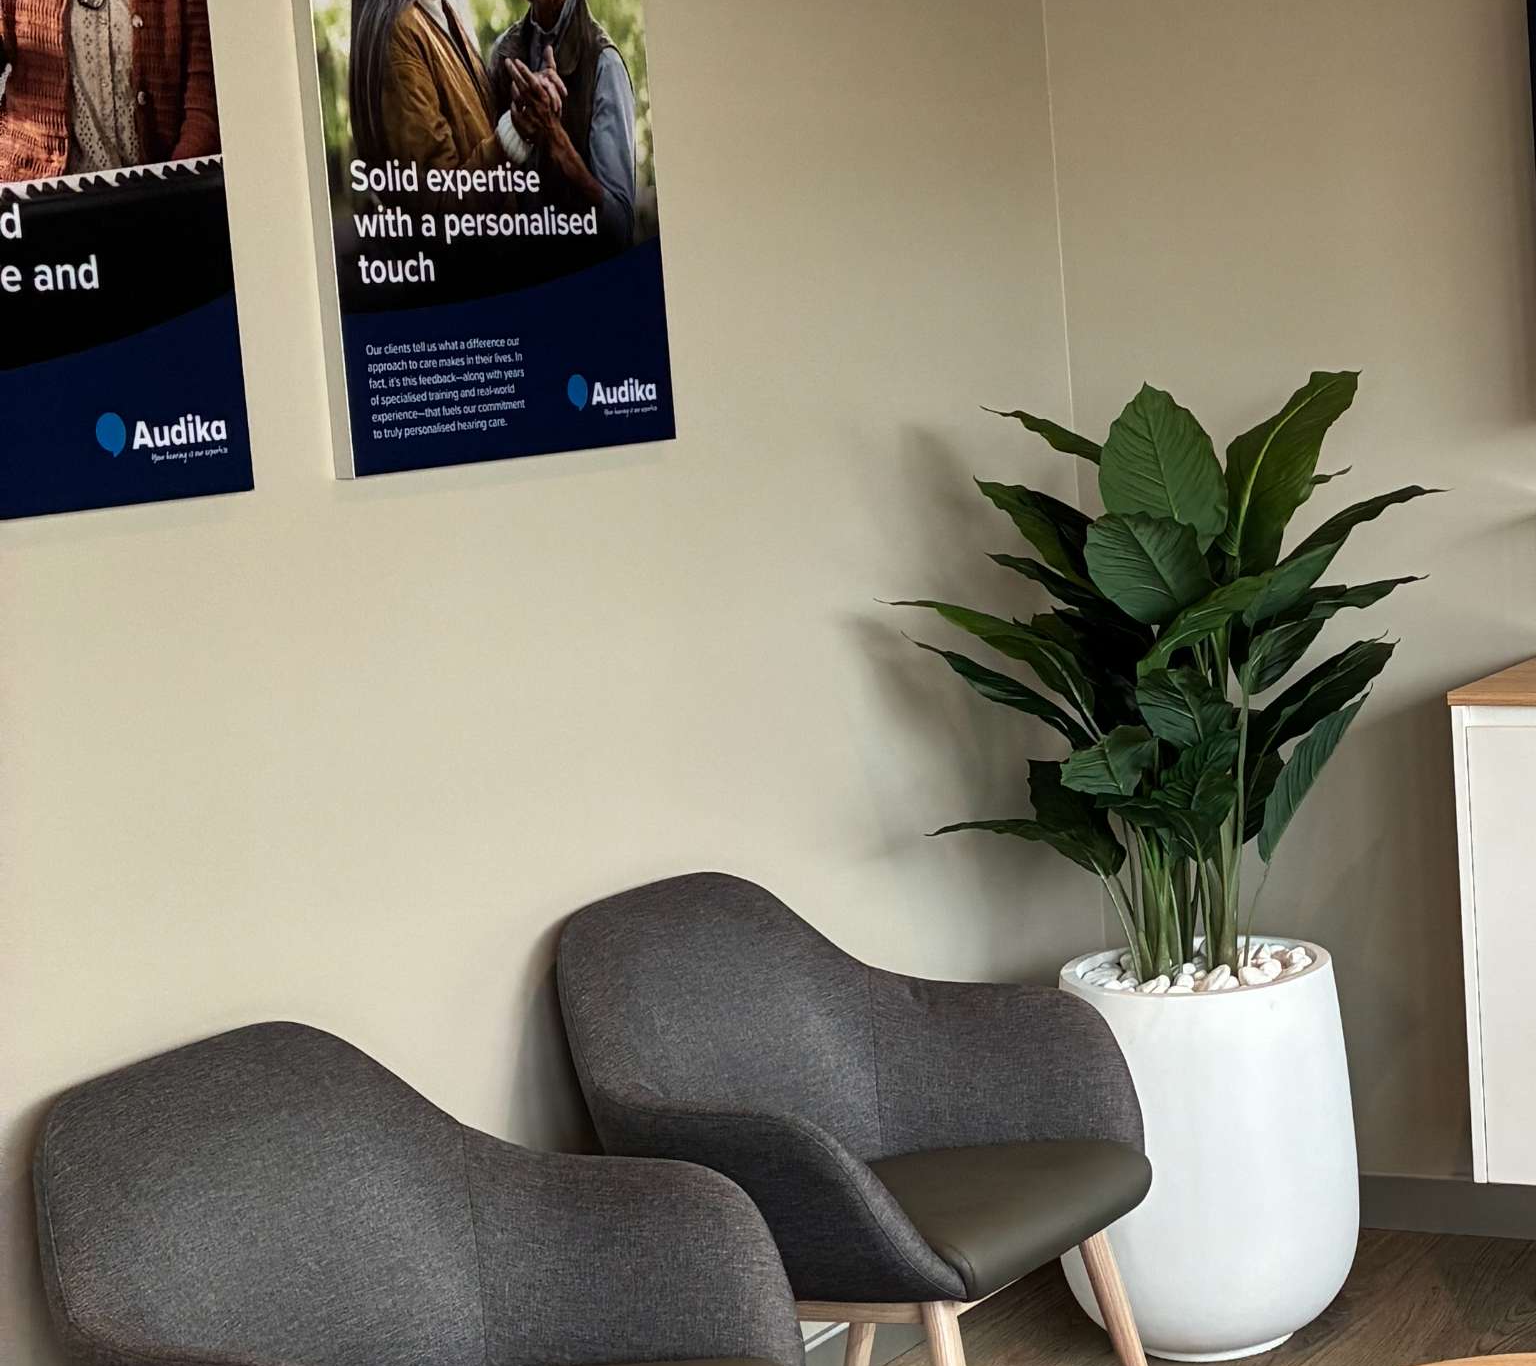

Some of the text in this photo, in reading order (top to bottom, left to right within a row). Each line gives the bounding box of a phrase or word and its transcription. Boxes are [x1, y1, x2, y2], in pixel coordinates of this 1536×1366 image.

[350, 158, 540, 200] Solid expertise
[353, 205, 598, 244] with a personalised
[33, 253, 99, 292] and
[357, 251, 436, 284] touch
[366, 344, 382, 356] Our
[384, 343, 411, 355] clients
[412, 341, 426, 353] tell
[427, 342, 437, 352] us
[438, 340, 458, 351] what
[459, 341, 466, 350] a
[466, 338, 506, 349] difference
[367, 352, 523, 374] approach to care makes in their lives. In
[369, 378, 388, 390] fact,
[402, 376, 418, 387] this
[486, 369, 503, 380] with
[503, 368, 525, 380] years
[592, 377, 657, 406] Audika
[370, 384, 515, 407] of specialised training and real-world
[442, 405, 462, 417] fuels
[463, 405, 477, 414] our
[478, 399, 525, 413] commitment
[132, 413, 227, 450] Audika
[373, 417, 508, 440] to truly personalised hearing care.
